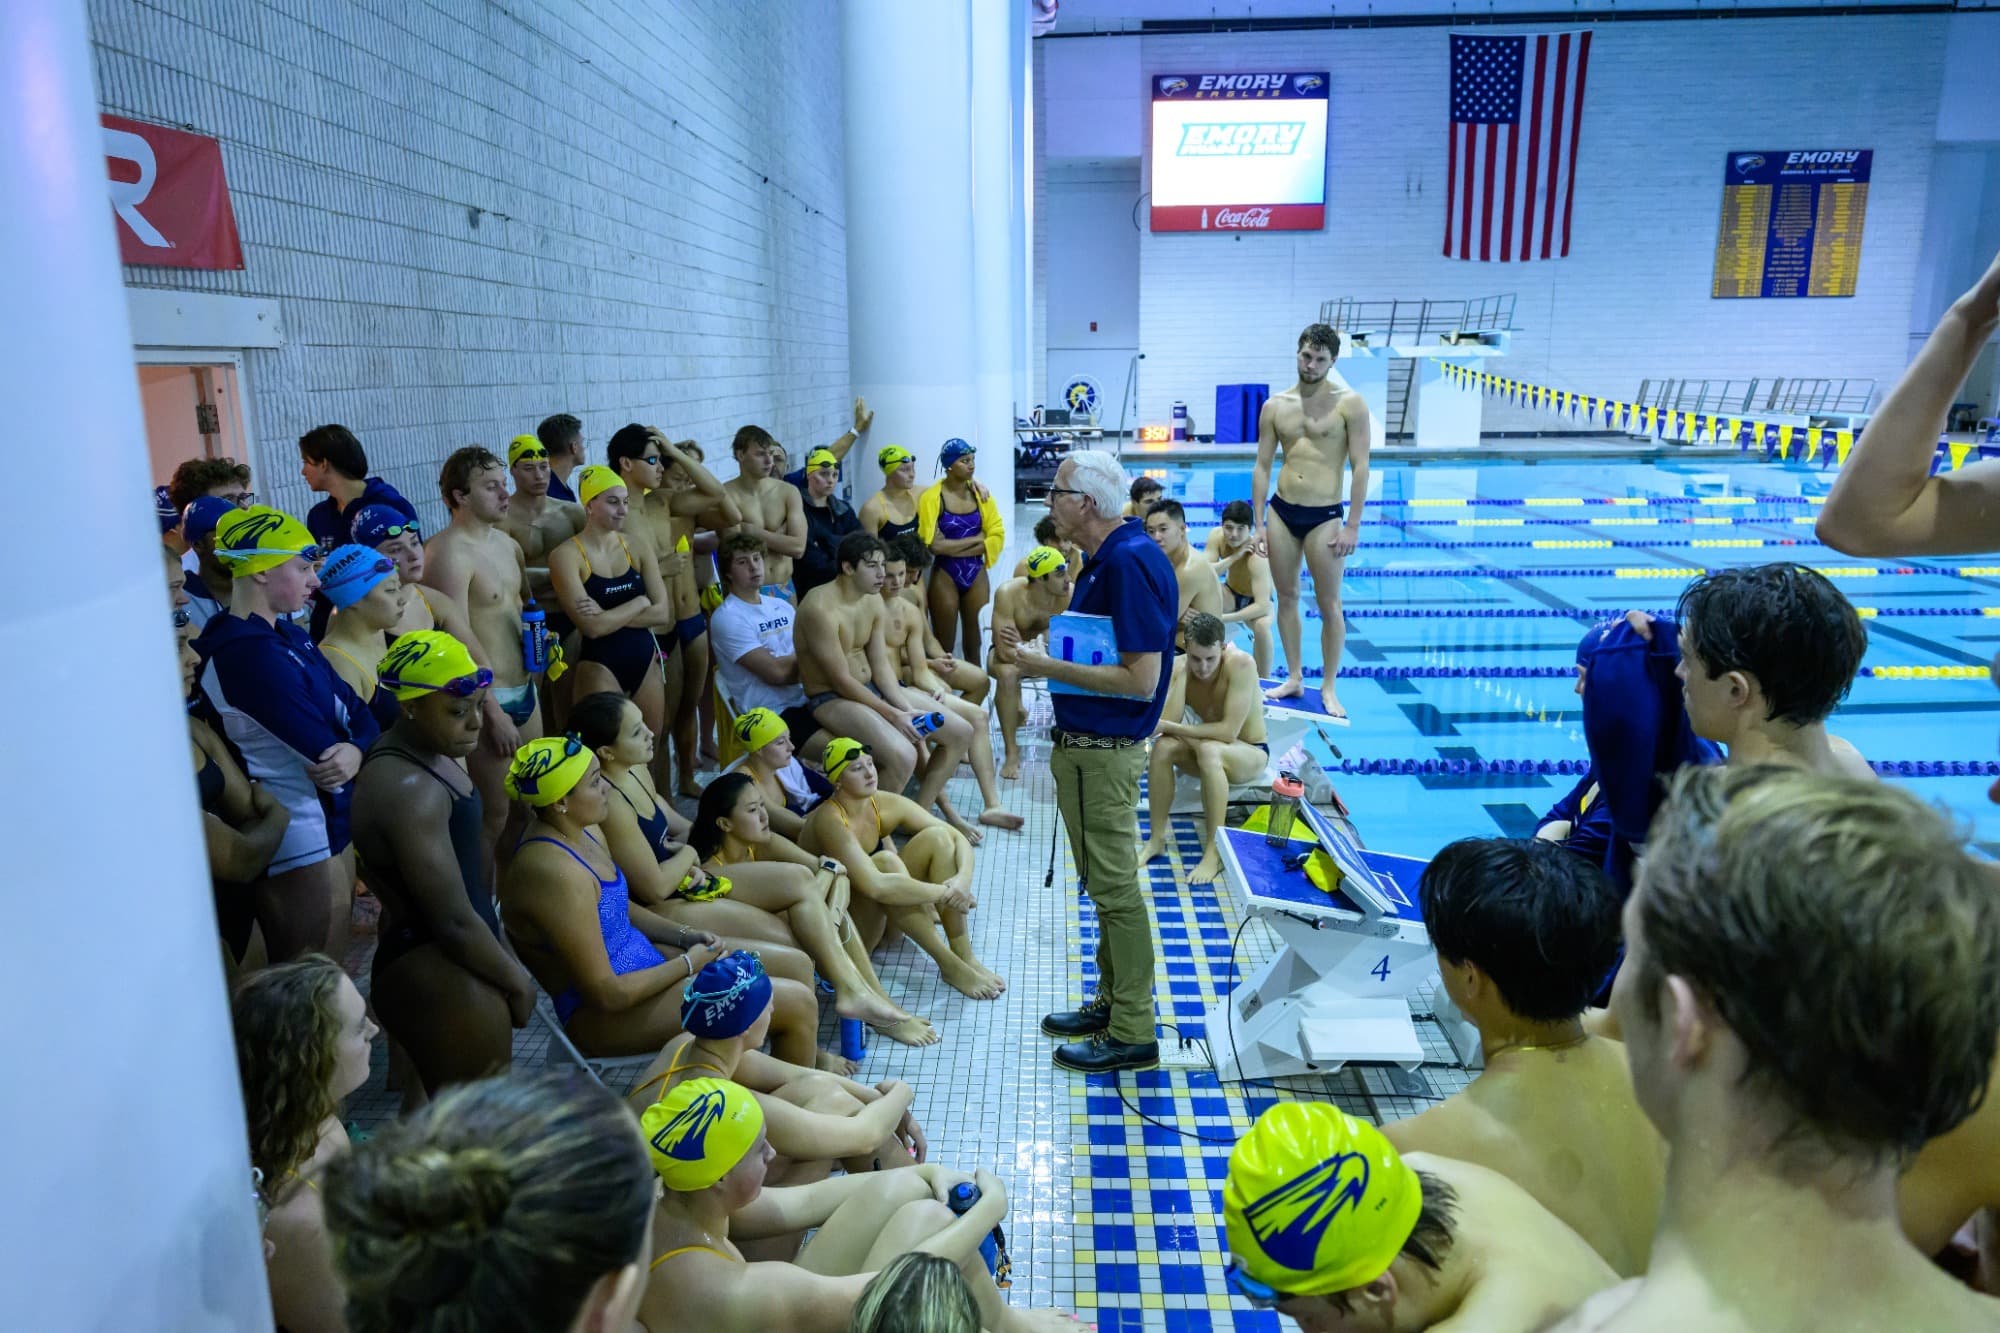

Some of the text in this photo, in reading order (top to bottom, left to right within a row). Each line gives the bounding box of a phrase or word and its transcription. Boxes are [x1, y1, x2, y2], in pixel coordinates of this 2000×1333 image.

[1199, 74, 1287, 90] EMORY
[1195, 90, 1280, 98] EAGLES
[1184, 125, 1301, 144] EMORY
[1786, 151, 1860, 164] EMORY
[1370, 954, 1392, 982] 4
